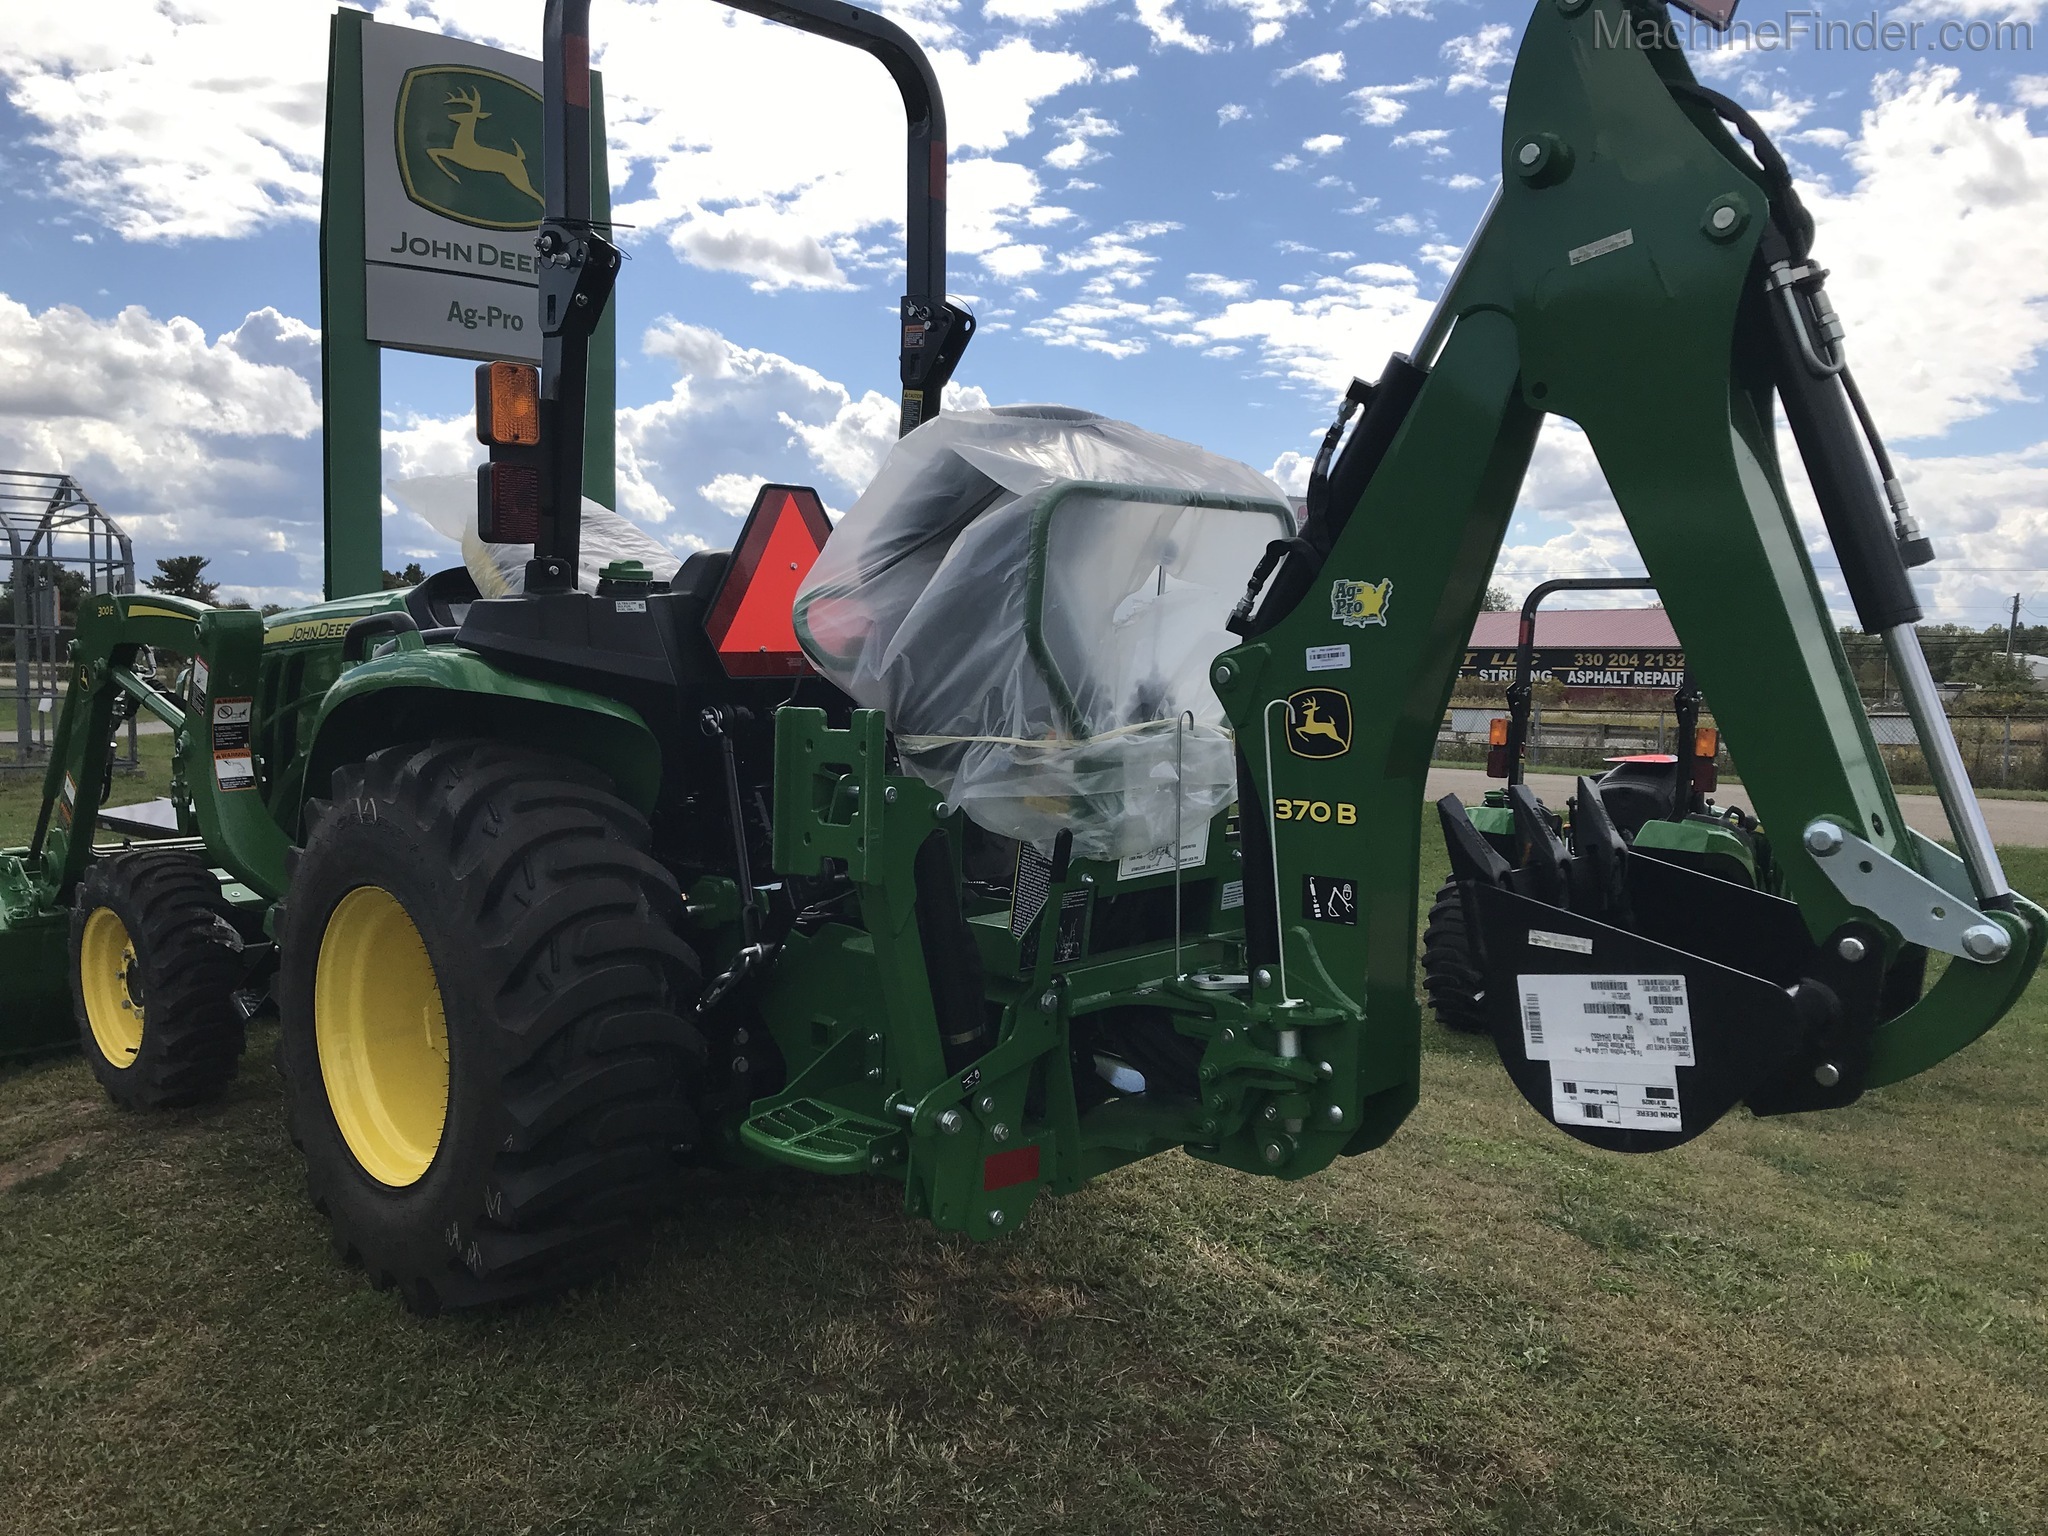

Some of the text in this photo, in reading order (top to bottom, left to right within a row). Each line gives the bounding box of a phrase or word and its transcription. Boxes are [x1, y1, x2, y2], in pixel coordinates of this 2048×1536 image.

[390, 231, 539, 274] JOHN DEE
[447, 300, 524, 332] Ag-Pro
[1335, 581, 1363, 602] Ag-
[1335, 598, 1364, 616] Pro
[289, 625, 318, 641] JOHN
[1574, 653, 1604, 667] 330
[1608, 653, 1640, 667] 204
[1644, 653, 1686, 668] 2132
[1479, 669, 1553, 683] STRING
[1567, 670, 1630, 684] ASPHALT
[1274, 798, 1358, 825] 370 B
[1636, 1109, 1680, 1119] JOHN DEERE
